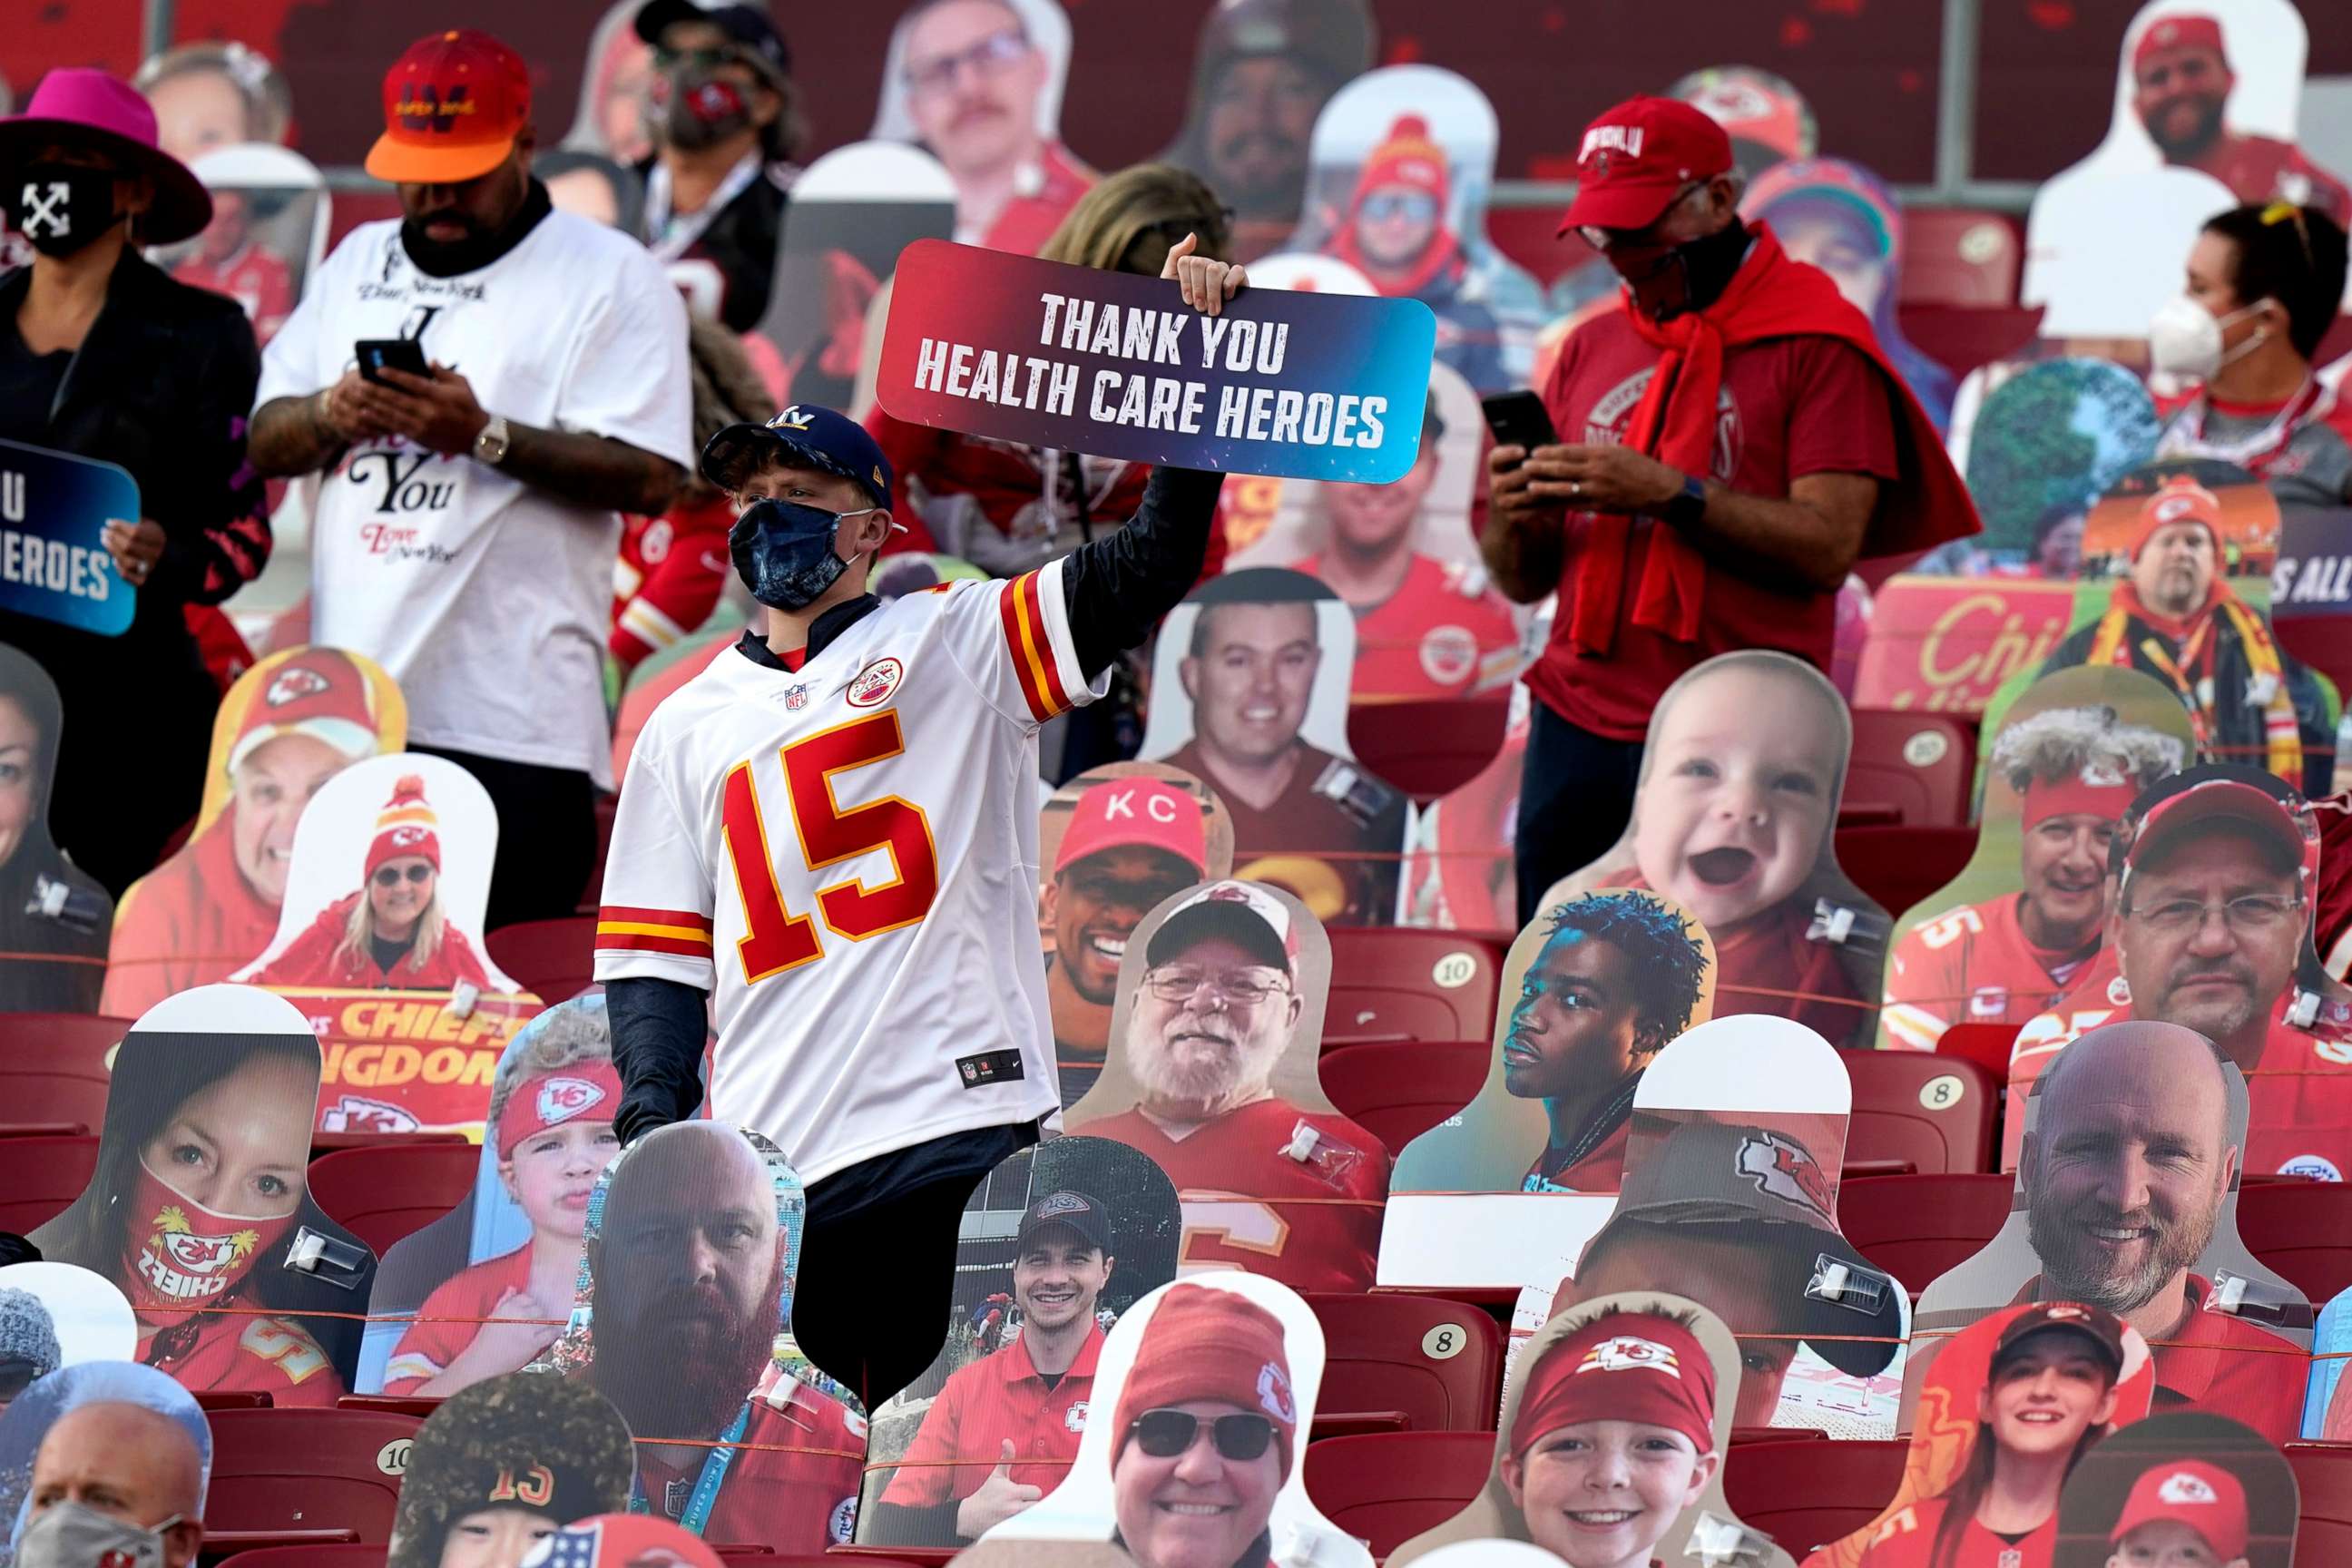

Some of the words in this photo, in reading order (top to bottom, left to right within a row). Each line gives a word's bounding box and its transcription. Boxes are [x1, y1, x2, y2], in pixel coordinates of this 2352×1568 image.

[1040, 293, 1189, 366] THANK
[1200, 316, 1289, 375] YOU
[914, 338, 1080, 416] HEALTH
[1089, 369, 1207, 435] CARE
[1215, 385, 1387, 449] HEROES
[349, 451, 455, 514] You
[0, 529, 109, 602] EROES
[2291, 555, 2352, 603] ALL
[786, 692, 808, 708] NFL
[722, 708, 939, 985] 15
[1443, 960, 1468, 982] 10
[1934, 1083, 1950, 1103] 8
[1436, 1331, 1453, 1353] 8
